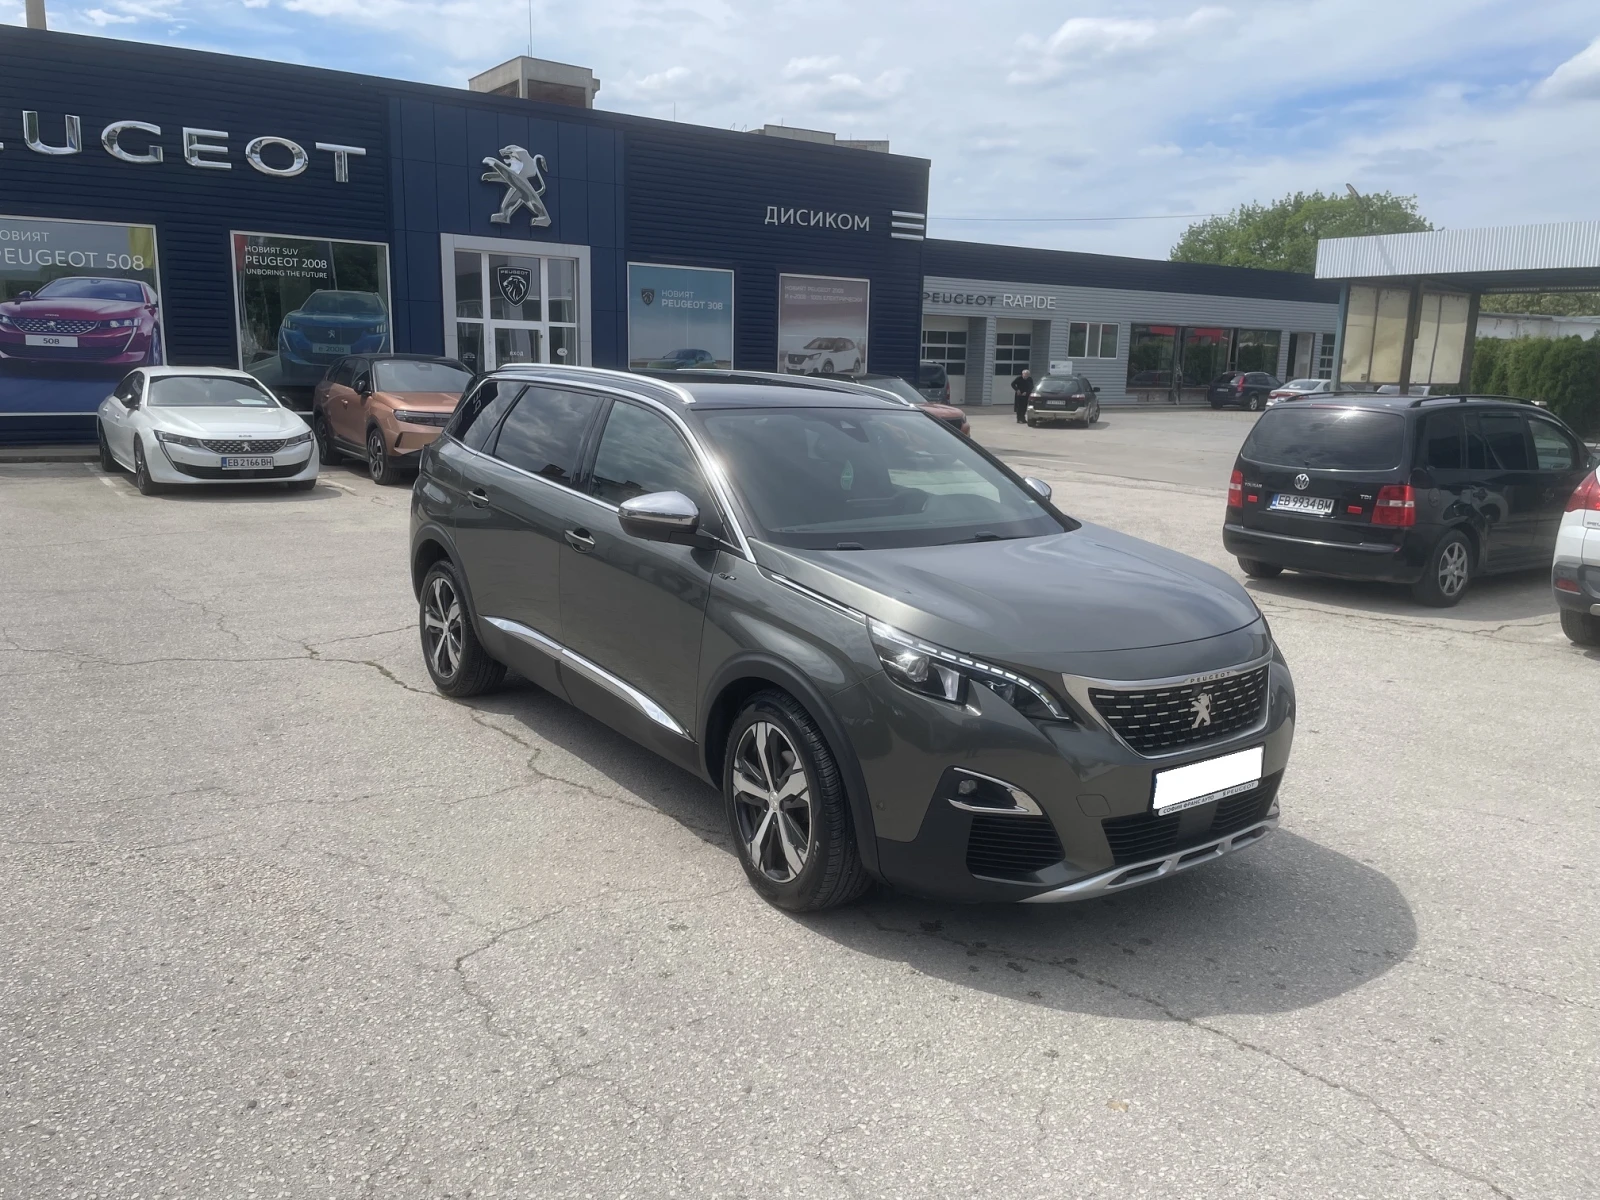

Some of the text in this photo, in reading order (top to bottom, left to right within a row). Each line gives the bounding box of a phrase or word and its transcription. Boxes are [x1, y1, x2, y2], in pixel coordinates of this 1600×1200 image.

[0, 110, 366, 183] UGEOT
[764, 206, 870, 232] ДИСИКОМ
[244, 245, 299, 255] НОВИЯТ SUV
[0, 247, 145, 271] EUGEOT 508
[245, 255, 328, 269] PEUGEOT 2008
[246, 268, 328, 279] UNBORING THE FUTURE
[661, 289, 695, 298] НОВИЯТ
[661, 299, 724, 310] PEUGEOT 308
[922, 292, 1056, 310] PEUGEOT RAPIDE
[240, 458, 260, 467] 2166
[1277, 495, 1332, 511] EB 9934 BM
[1190, 671, 1231, 683] PEUGEOT
[1226, 782, 1256, 796] PEUGEOT
